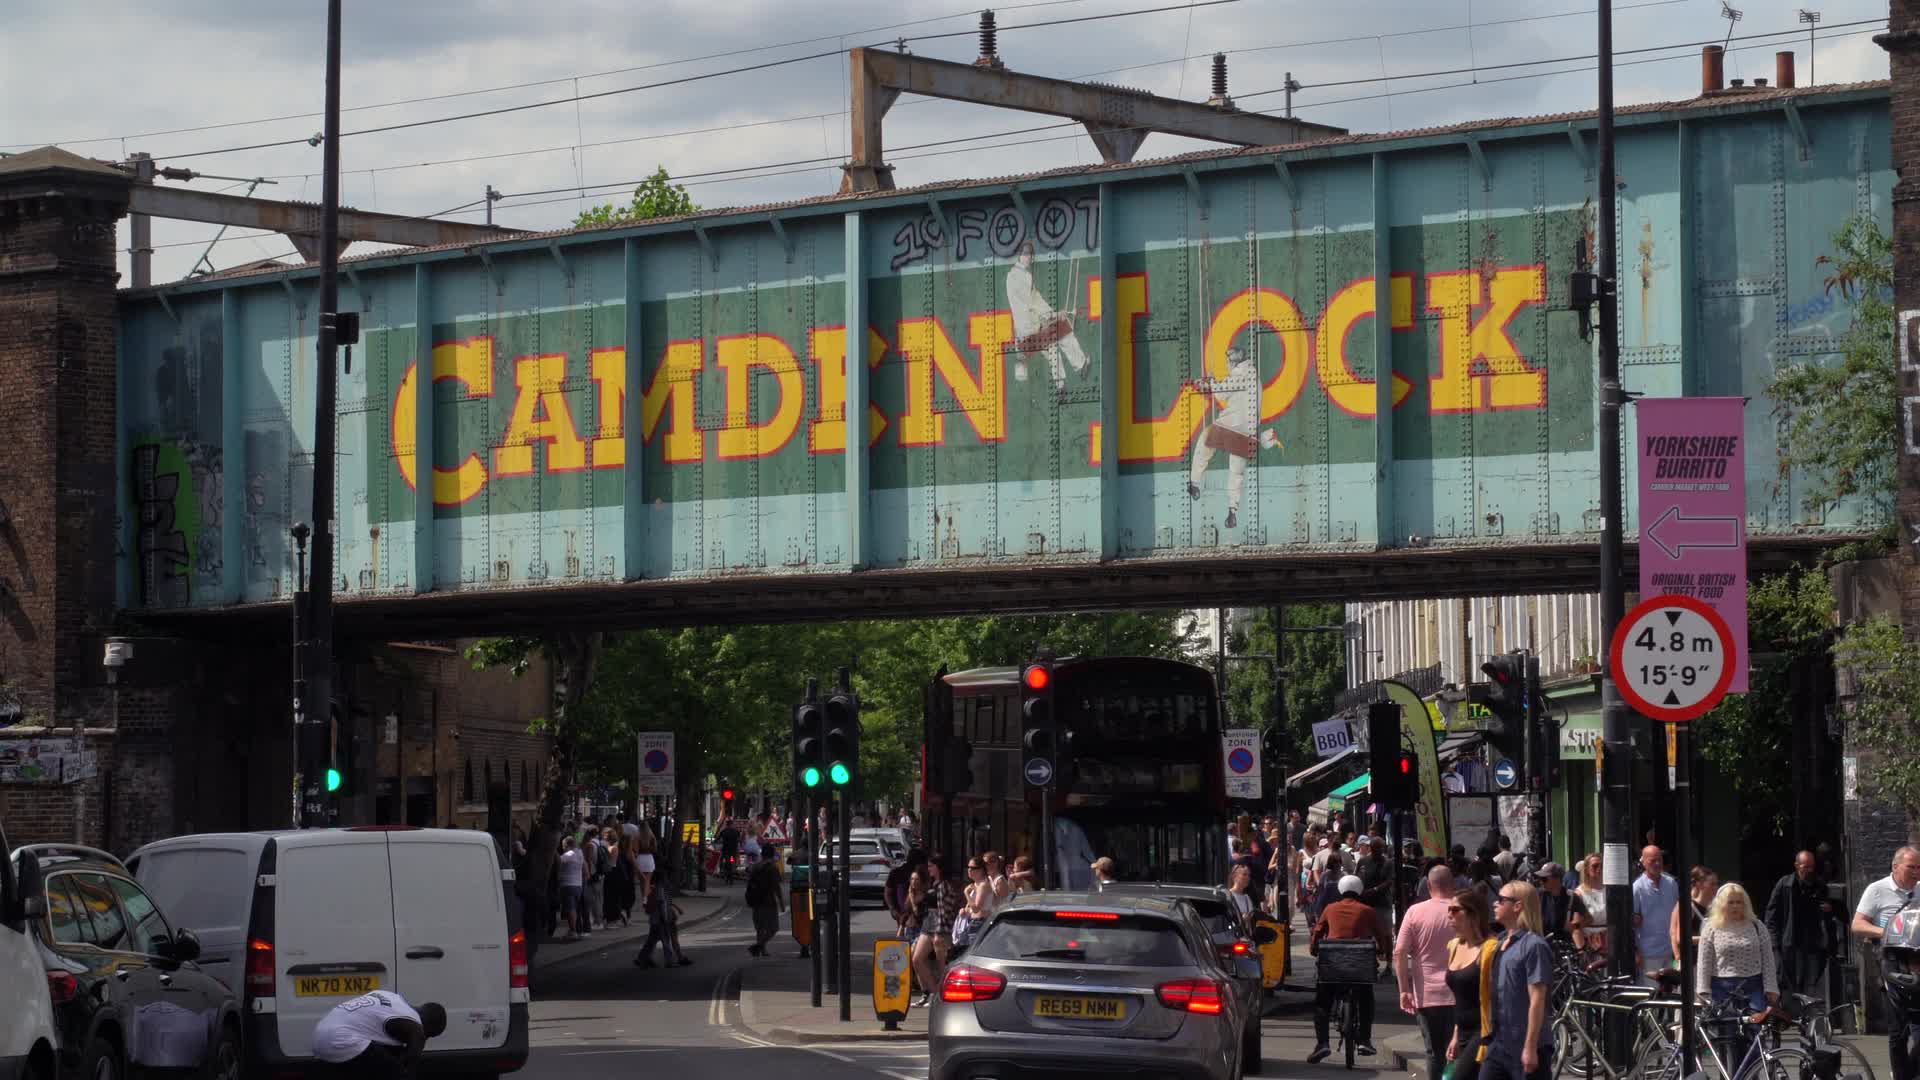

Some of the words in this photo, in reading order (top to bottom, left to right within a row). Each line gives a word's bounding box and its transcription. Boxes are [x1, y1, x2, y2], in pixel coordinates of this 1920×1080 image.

[392, 309, 1018, 507] CAMDEN
[1088, 264, 1547, 467] LOCK
[1646, 436, 1738, 457] YORKSHIRE
[1656, 458, 1727, 479] BURRITO
[1651, 573, 1695, 586] ORIGINAL
[1698, 573, 1736, 586] BRITISH
[1698, 586, 1724, 599] FOOD
[1635, 627, 1685, 653] 4.8
[1692, 637, 1713, 652] m
[1228, 739, 1253, 747] ZONE
[1317, 731, 1348, 751] BBQ
[1039, 999, 1082, 1014] RE69
[1086, 1000, 1118, 1017] NMM
